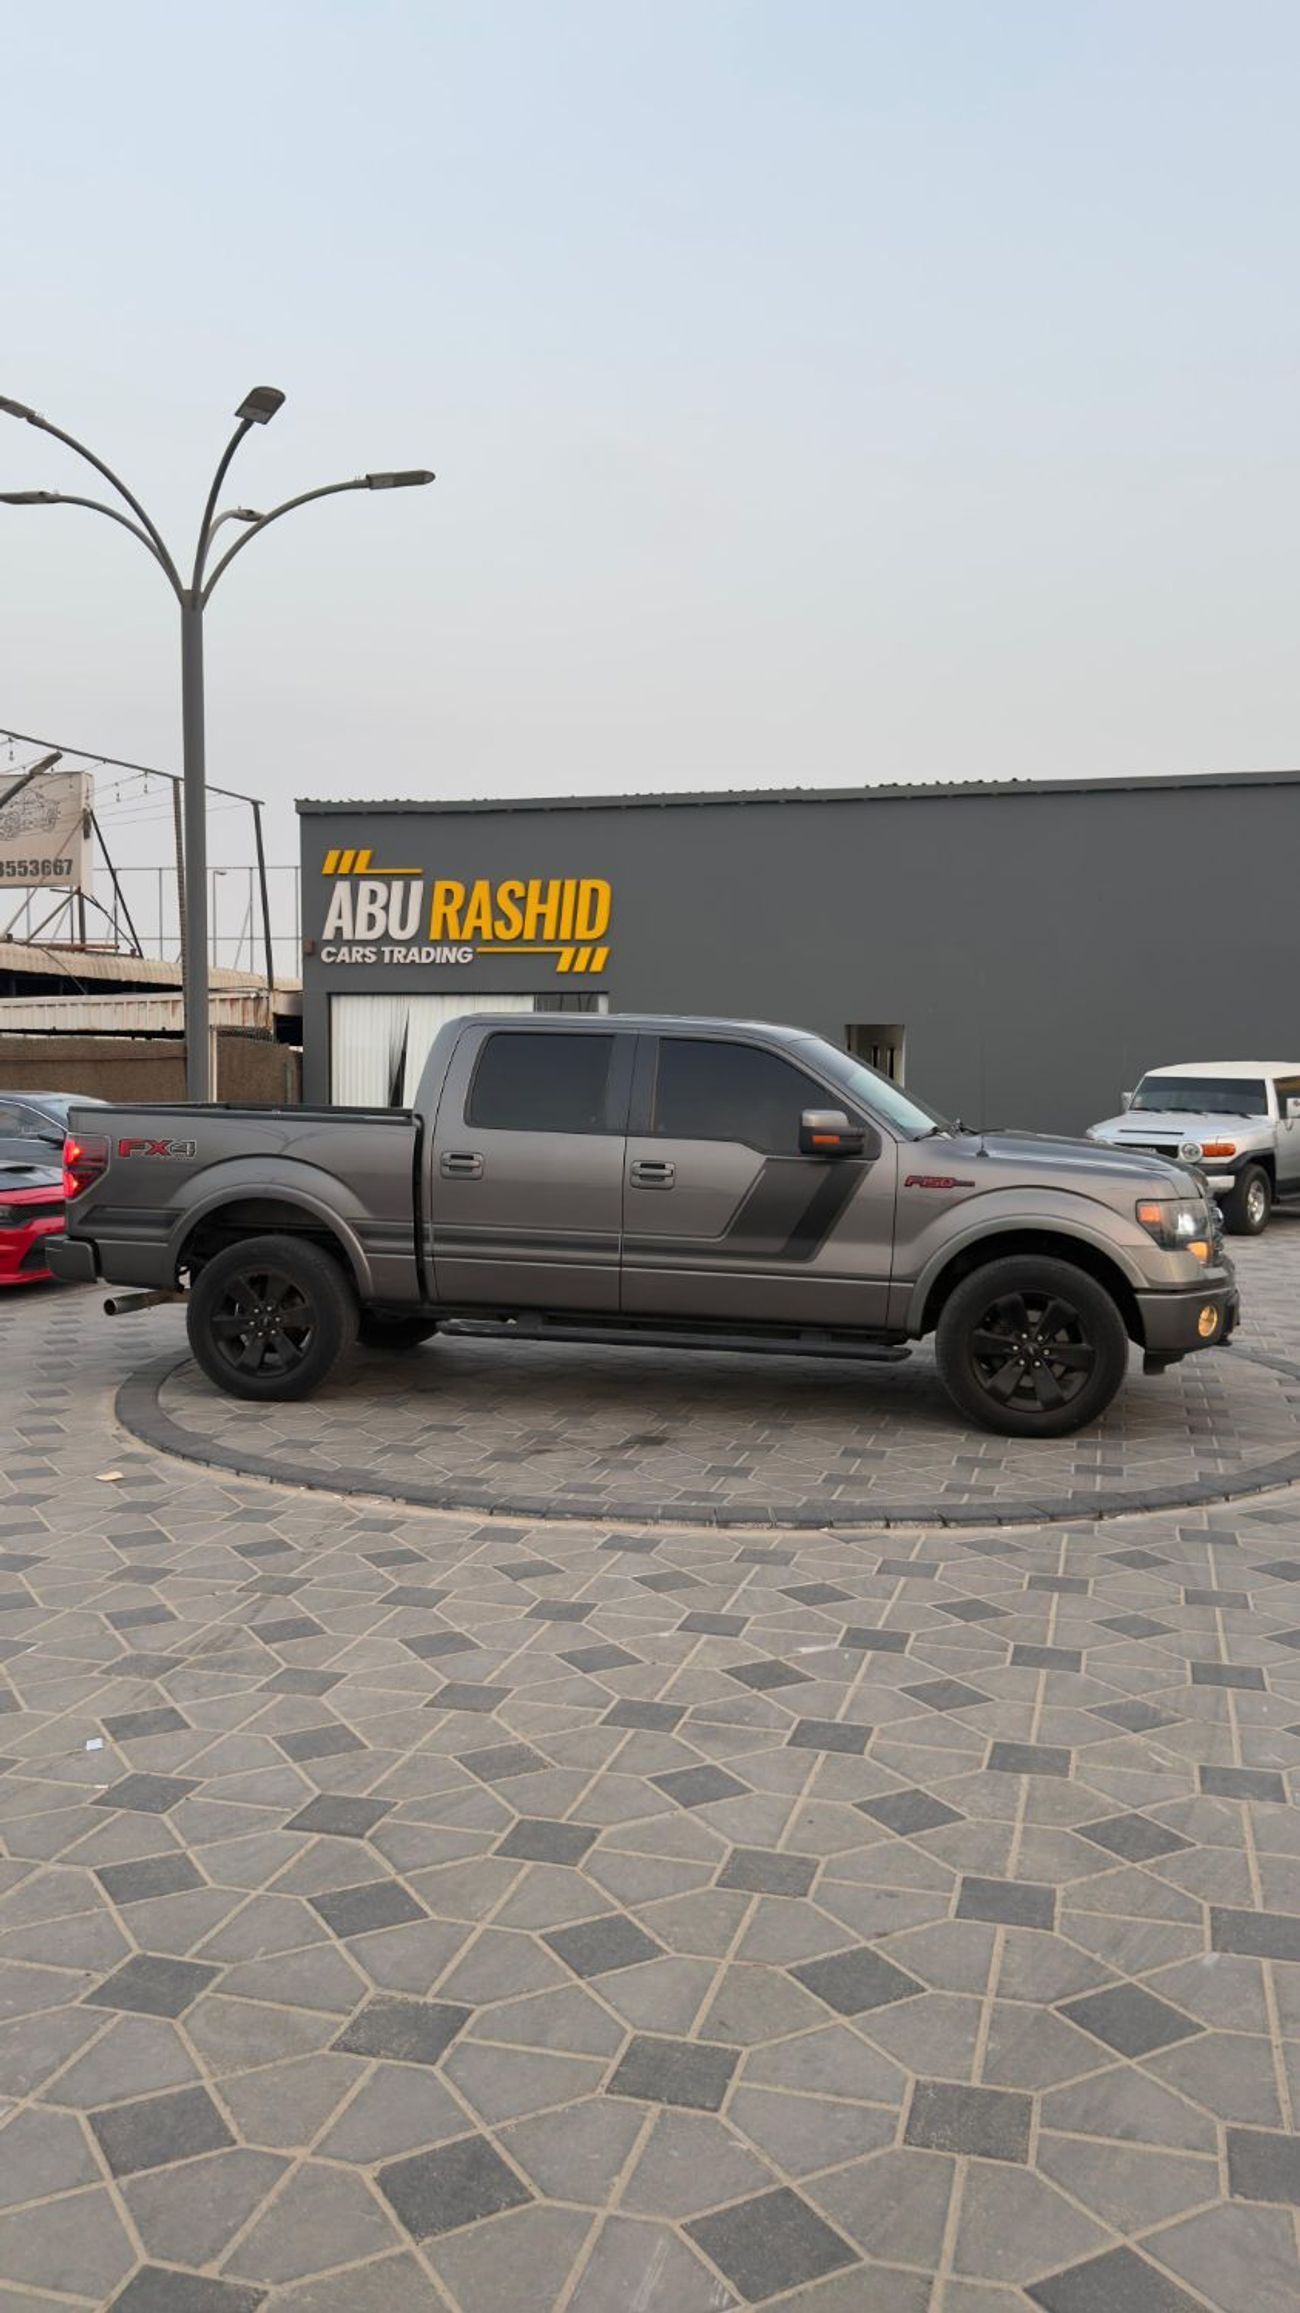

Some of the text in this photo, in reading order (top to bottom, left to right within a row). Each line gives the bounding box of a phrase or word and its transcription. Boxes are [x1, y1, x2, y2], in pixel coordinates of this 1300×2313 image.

[321, 879, 612, 940] ABU RASHID
[320, 946, 474, 963] CARS TRADING
[118, 1138, 197, 1159] FX4
